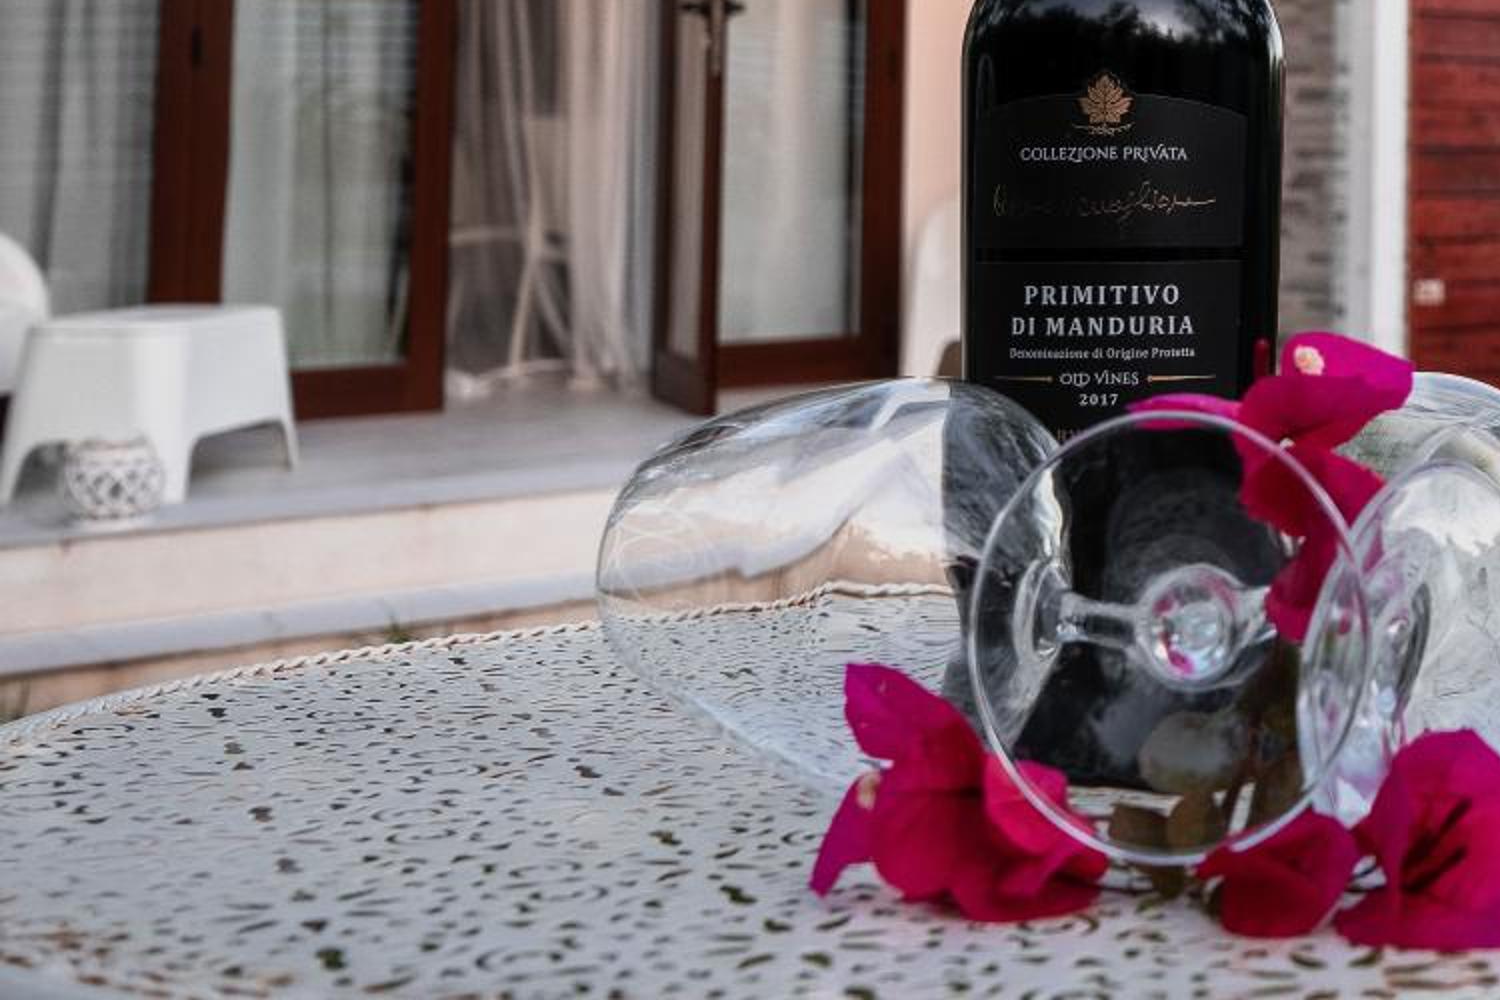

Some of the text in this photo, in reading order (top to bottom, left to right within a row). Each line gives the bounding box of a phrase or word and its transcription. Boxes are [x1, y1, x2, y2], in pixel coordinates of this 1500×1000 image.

[1020, 146, 1118, 163] COLLEZIONE
[1024, 284, 1180, 306] PRIMITIVO
[1012, 315, 1195, 337] DI MANDURIA
[1009, 346, 1089, 360] Denominazione
[1091, 347, 1104, 360] di
[1106, 347, 1149, 361] Origine
[1095, 368, 1140, 386] VINES
[1079, 393, 1119, 406] 2017
